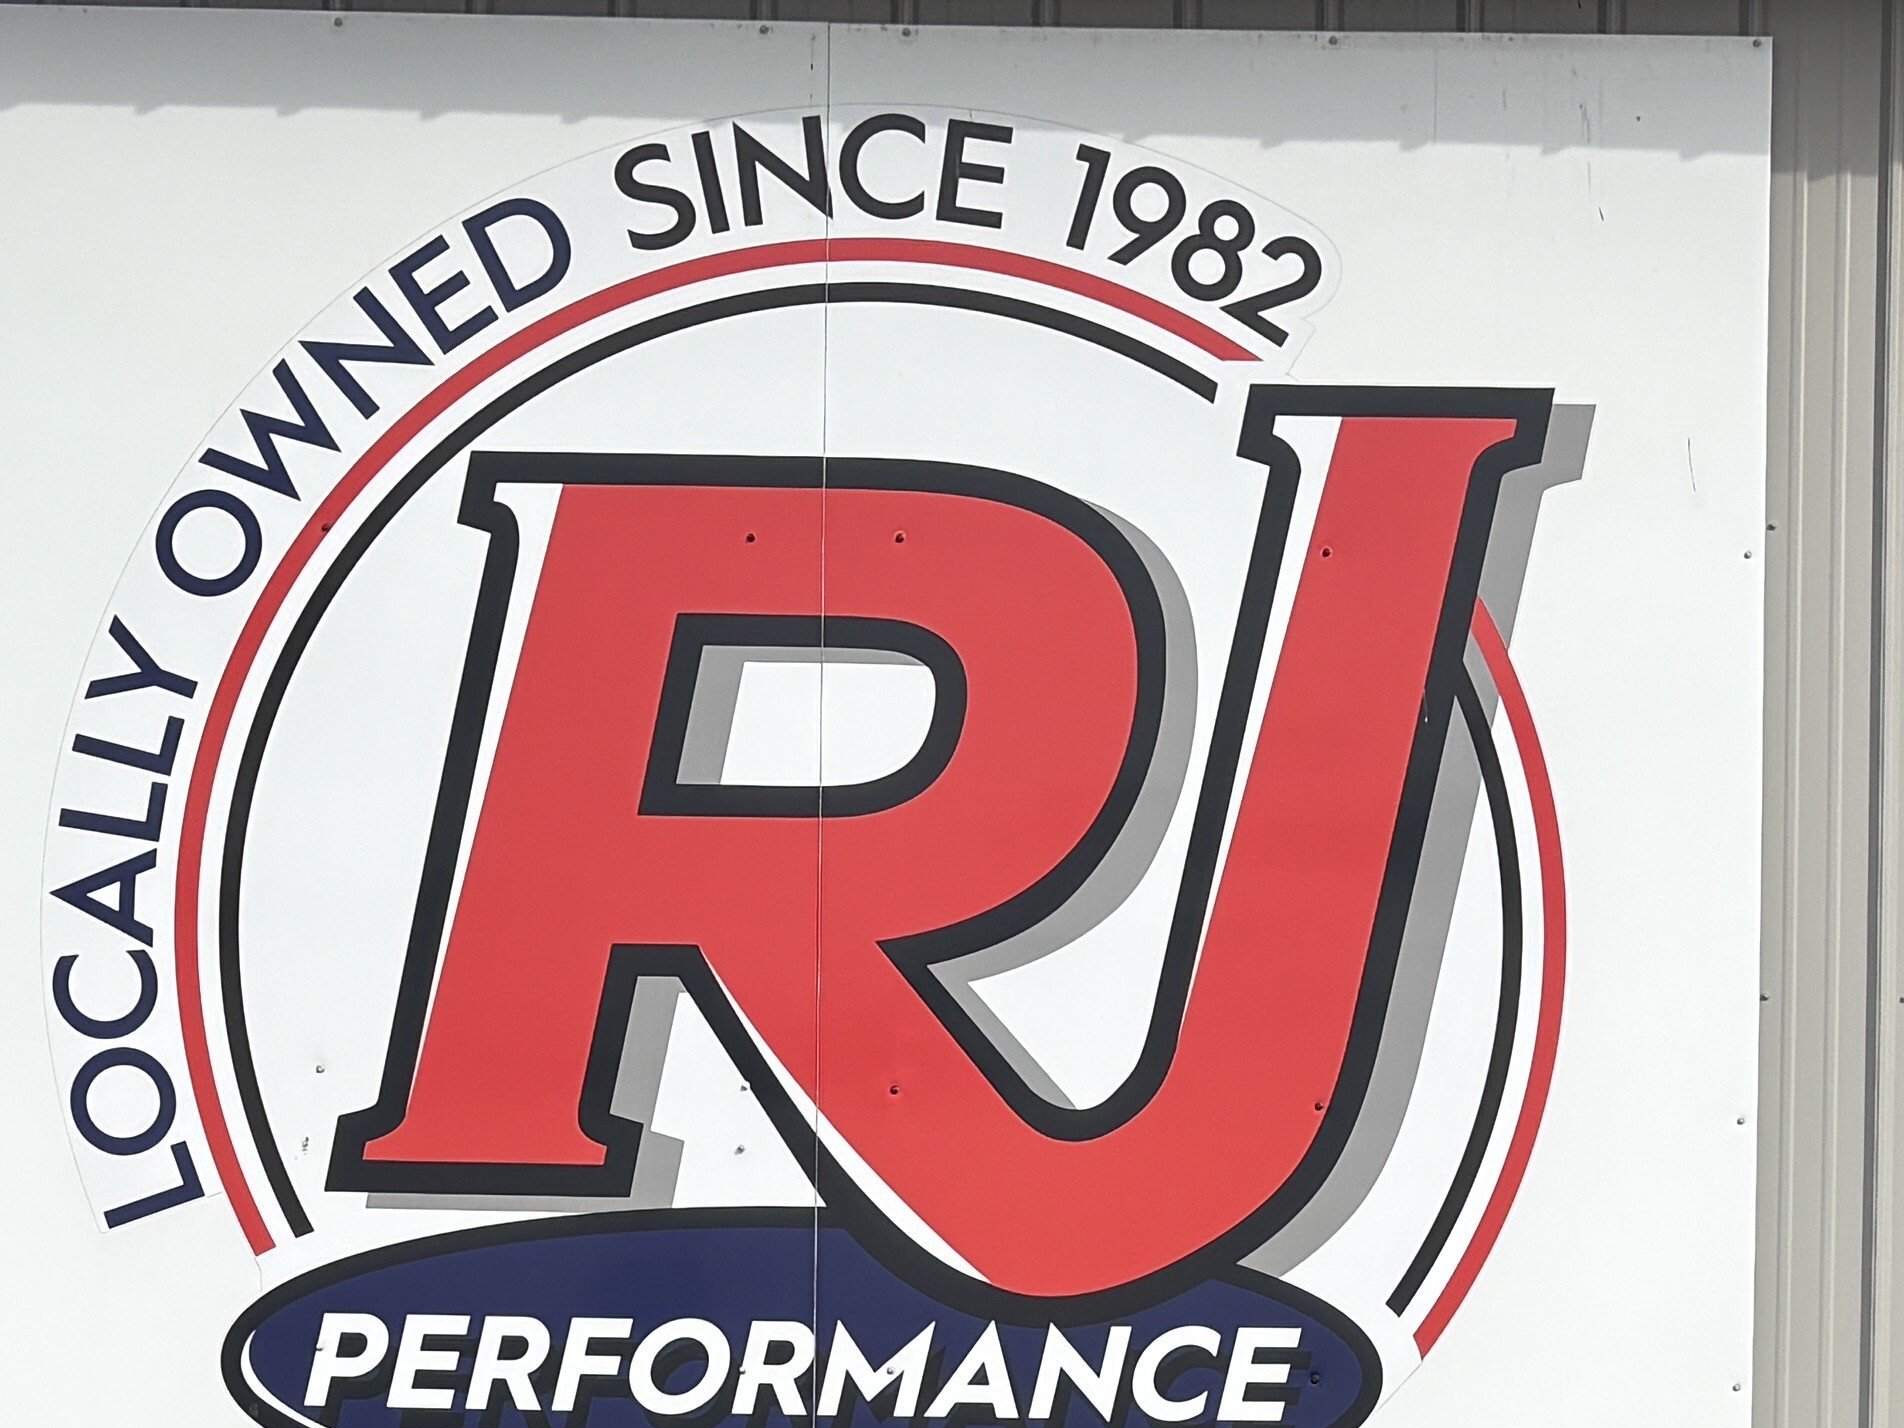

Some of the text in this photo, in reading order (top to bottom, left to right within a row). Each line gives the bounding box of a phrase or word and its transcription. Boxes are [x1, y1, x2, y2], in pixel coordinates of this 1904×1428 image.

[49, 112, 1325, 1229] LOCALLY OWNED SINCE 1982
[326, 385, 1556, 1320] RJ
[304, 1313, 1304, 1426] PERFORMANCE
